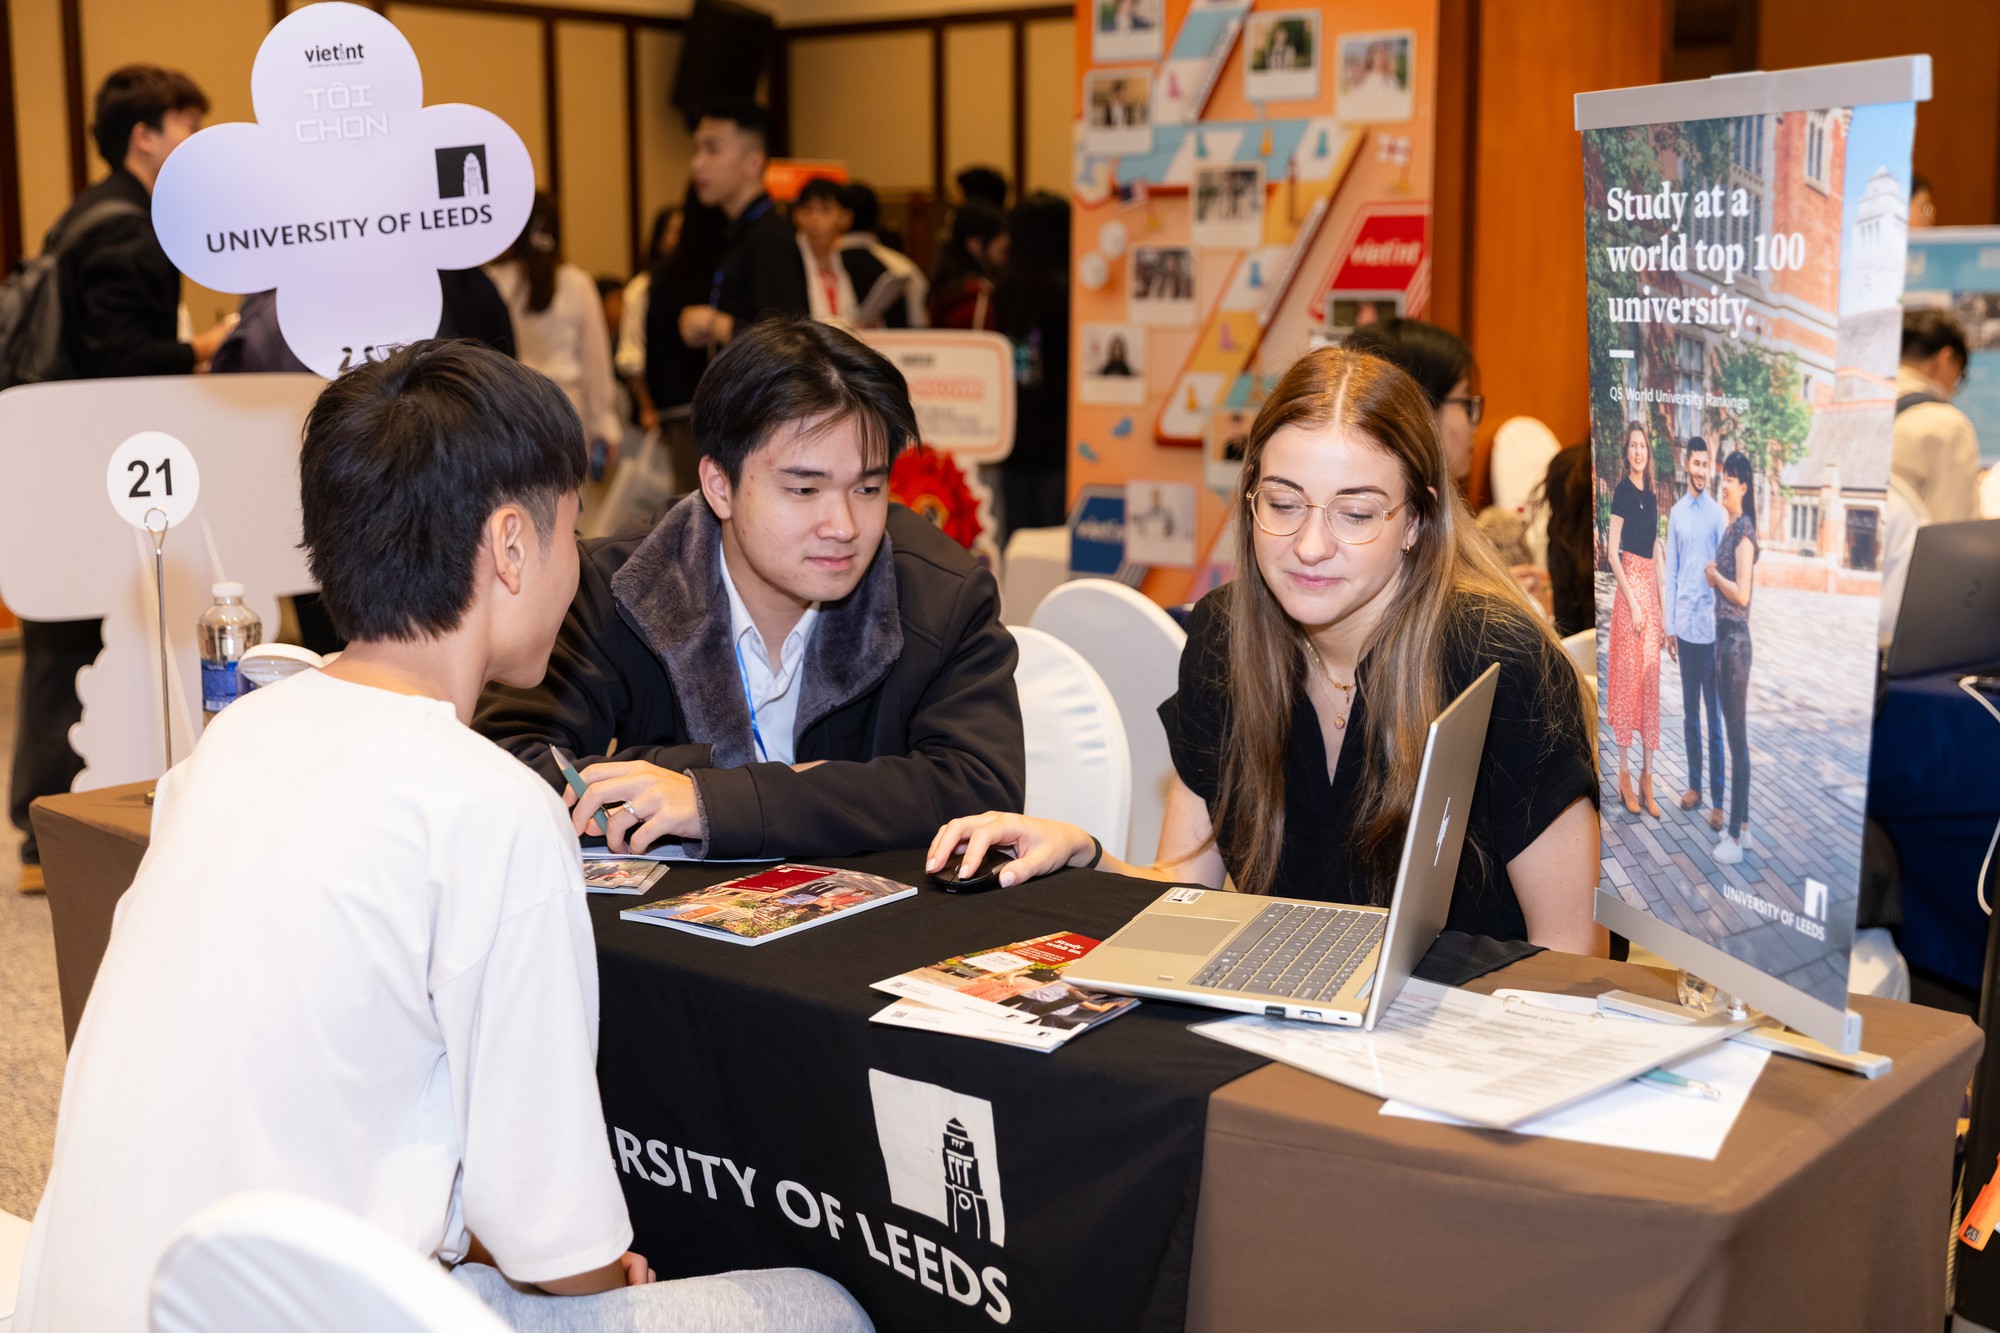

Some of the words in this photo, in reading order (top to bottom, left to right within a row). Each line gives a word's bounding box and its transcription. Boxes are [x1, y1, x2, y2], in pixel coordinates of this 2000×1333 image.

[304, 43, 364, 63] vietint
[303, 81, 374, 112] TÔI
[295, 112, 389, 145] CHỌN
[206, 217, 369, 253] UNIVERSITY
[378, 213, 411, 236] OF
[420, 204, 493, 231] LEEDS
[1606, 181, 1688, 231] Study
[1694, 184, 1725, 218] at
[1731, 188, 1750, 218] a
[1606, 232, 1688, 273] world
[1695, 239, 1745, 284] top
[1754, 232, 1806, 272] 100
[1607, 285, 1755, 339] university.
[1609, 386, 1624, 402] QS
[1625, 387, 1654, 402] World
[1655, 389, 1704, 411] University
[1705, 393, 1750, 414] Rankings
[127, 458, 173, 498] 21
[1723, 884, 1780, 920] UNIVERSITY
[1780, 910, 1795, 926] OF
[1796, 917, 1825, 942] LEEDS
[612, 1126, 757, 1208] RSITY
[775, 1179, 845, 1240] OF
[856, 1211, 1012, 1325] LEEDS
